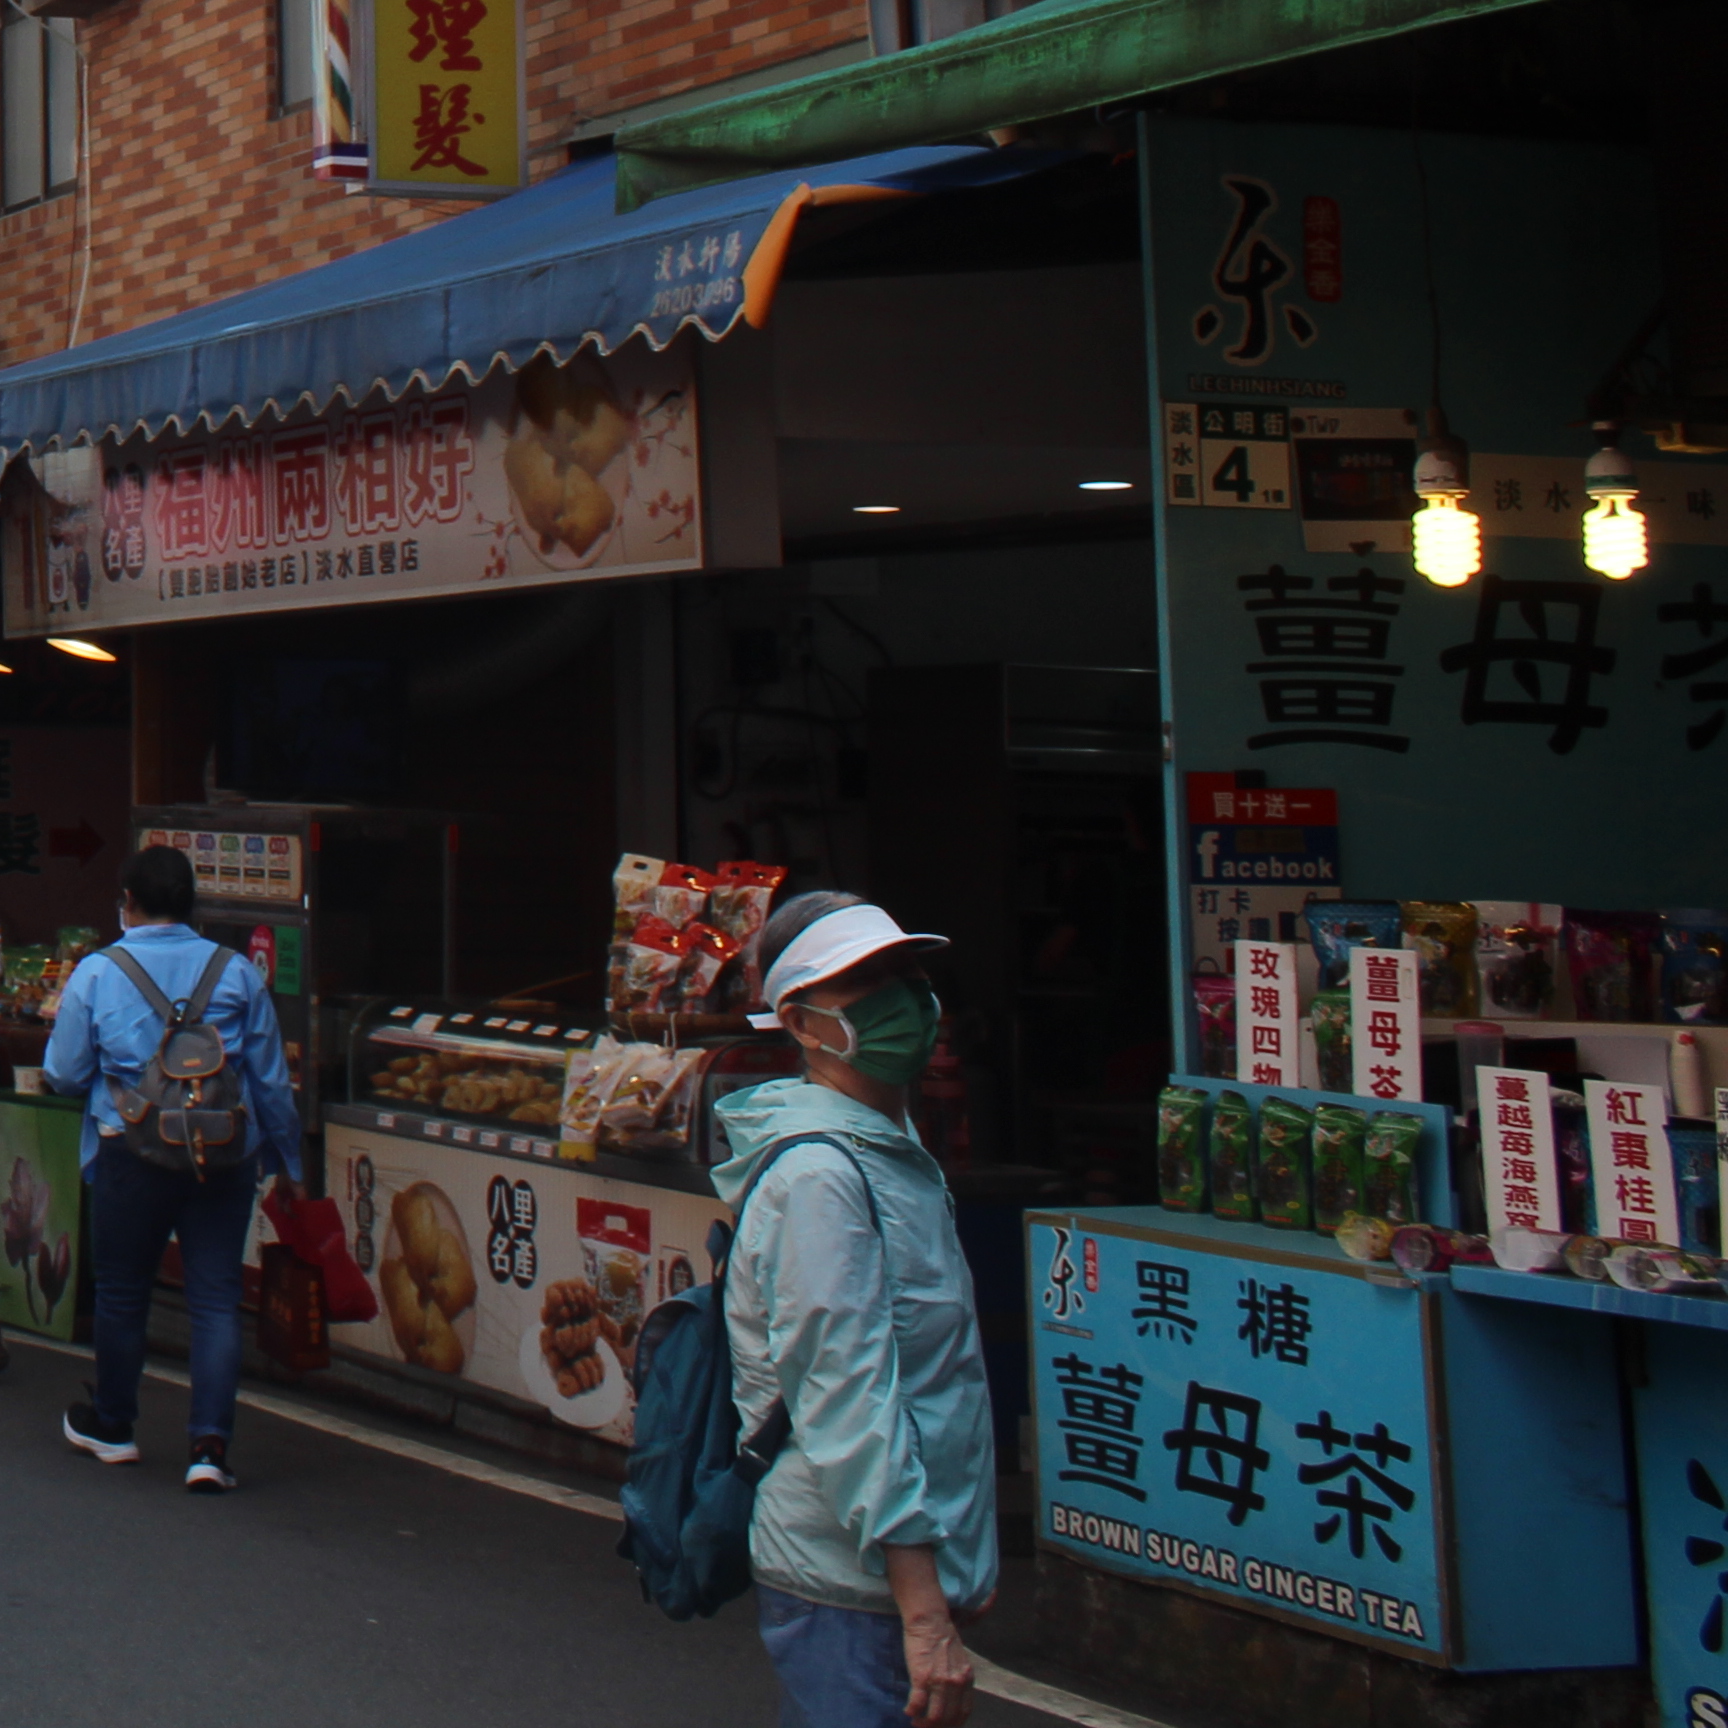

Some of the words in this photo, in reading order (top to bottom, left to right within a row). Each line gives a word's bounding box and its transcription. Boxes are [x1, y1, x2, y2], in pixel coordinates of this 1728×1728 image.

[1203, 408, 1285, 439] 公明街
[153, 394, 476, 561] 福州兩相好
[1169, 409, 1195, 504] 淡水區
[1210, 445, 1256, 503] 4
[1493, 477, 1717, 521] 淡水一味
[1212, 791, 1312, 820] 買十送一
[1196, 830, 1335, 879] facebook
[1196, 888, 1251, 914] 打卡
[1365, 955, 1403, 1099] 薑母茶
[1604, 1088, 1658, 1244] 紅棗桂圓
[487, 1182, 534, 1233] 八里
[488, 1236, 536, 1281] 名產
[1130, 1259, 1313, 1367] 黑糖
[1052, 1352, 1416, 1563] 薑母茶
[1051, 1503, 1141, 1555] BROWN
[1146, 1532, 1238, 1583] SUGAR
[1244, 1557, 1355, 1619] GINGER
[1361, 1592, 1424, 1640] TEA
